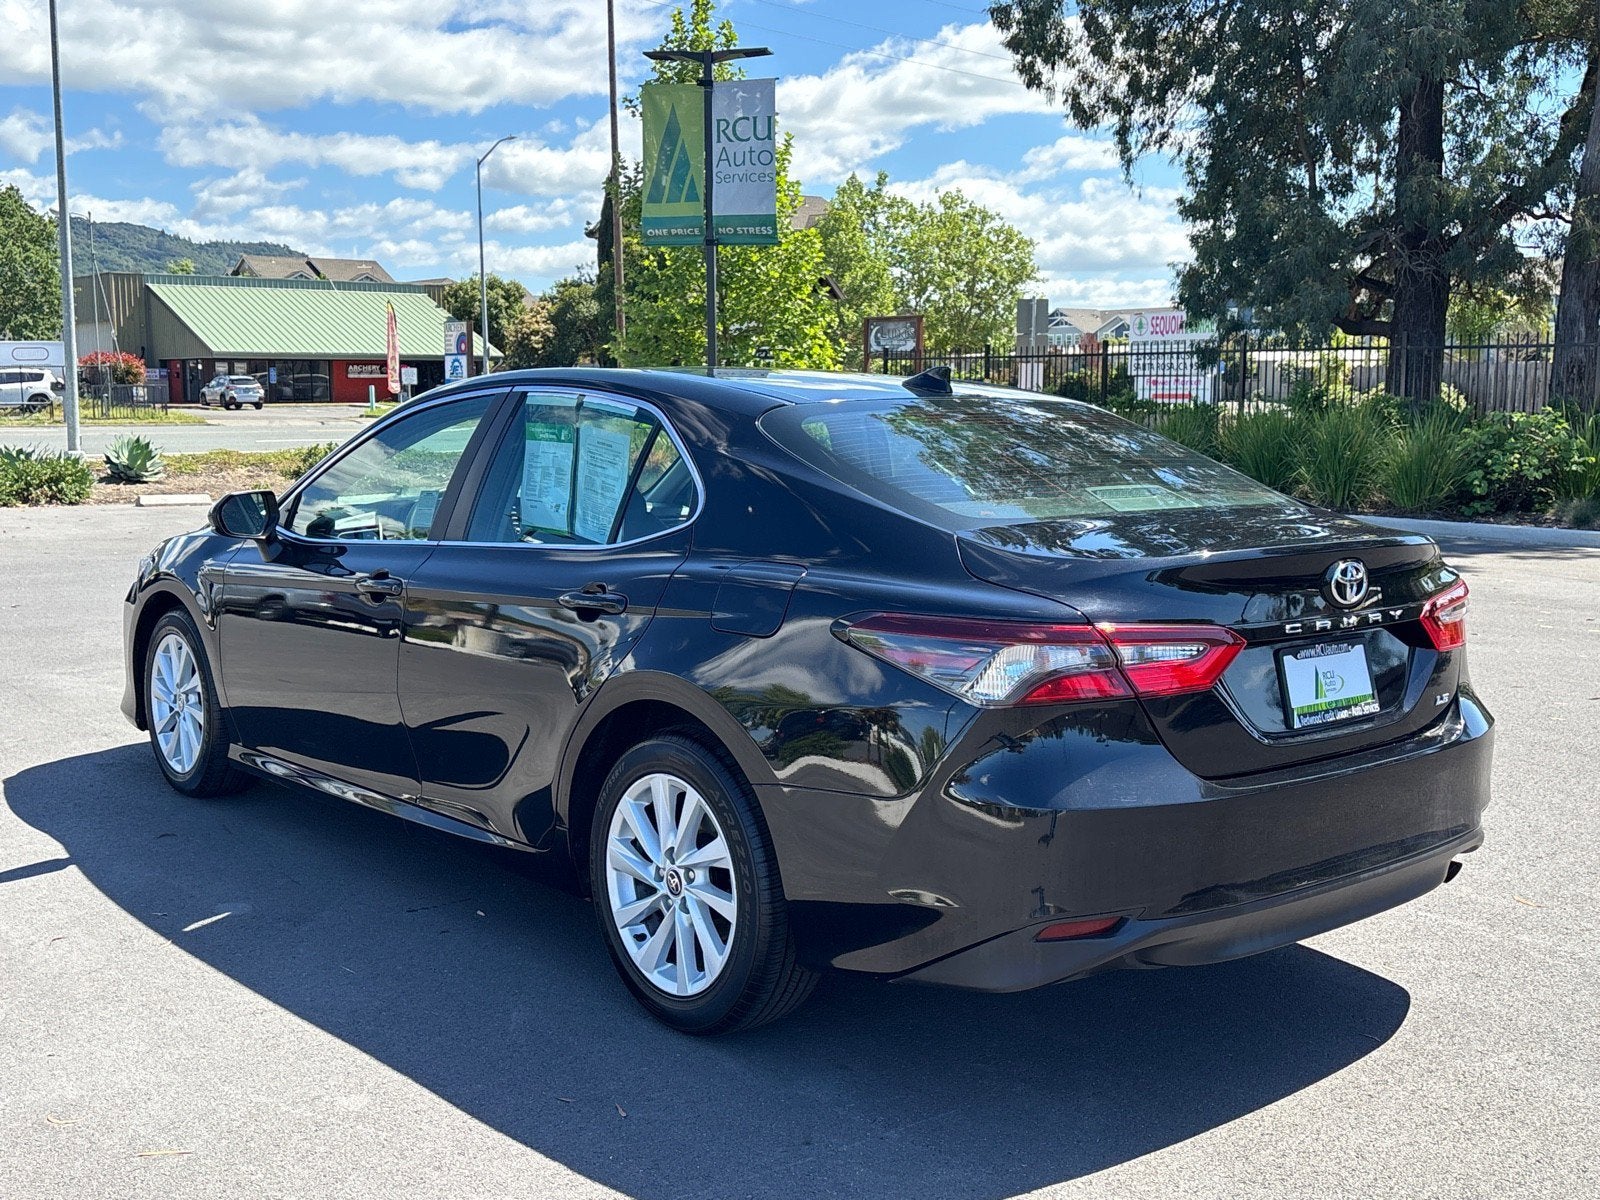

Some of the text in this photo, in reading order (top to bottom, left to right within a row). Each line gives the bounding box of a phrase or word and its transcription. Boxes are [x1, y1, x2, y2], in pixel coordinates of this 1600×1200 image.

[715, 115, 773, 143] RCU
[715, 146, 773, 168] Auto
[715, 170, 774, 184] Services
[647, 227, 700, 236] ONE PRICE
[718, 226, 773, 235] NO STRESS
[348, 364, 381, 373] ARCHERY
[1285, 609, 1403, 634] CAMRY
[1321, 709, 1336, 723] Credit
[707, 788, 752, 895] ATREZZO
